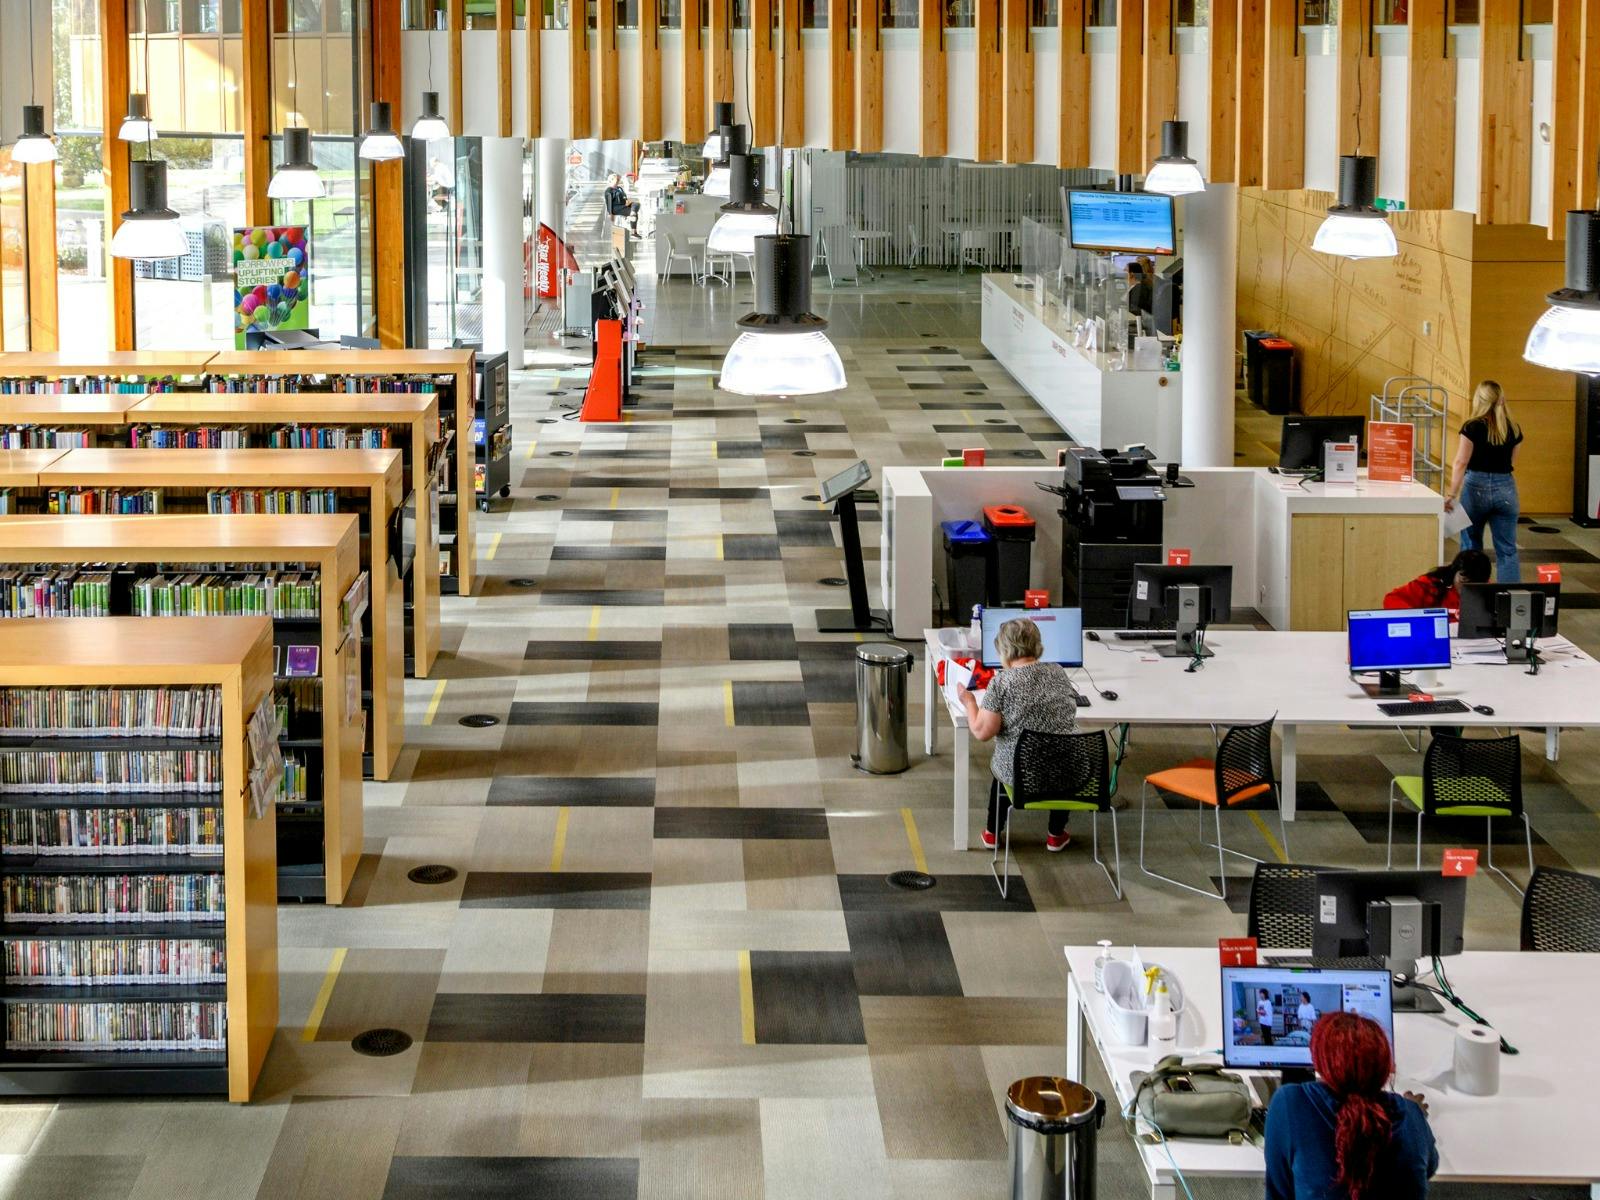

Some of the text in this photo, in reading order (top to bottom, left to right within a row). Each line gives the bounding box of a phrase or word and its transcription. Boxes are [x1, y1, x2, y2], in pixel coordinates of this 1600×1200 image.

[238, 258, 294, 269] BORROW FOR
[238, 268, 284, 277] UPLIFTING
[238, 276, 277, 286] STORIES
